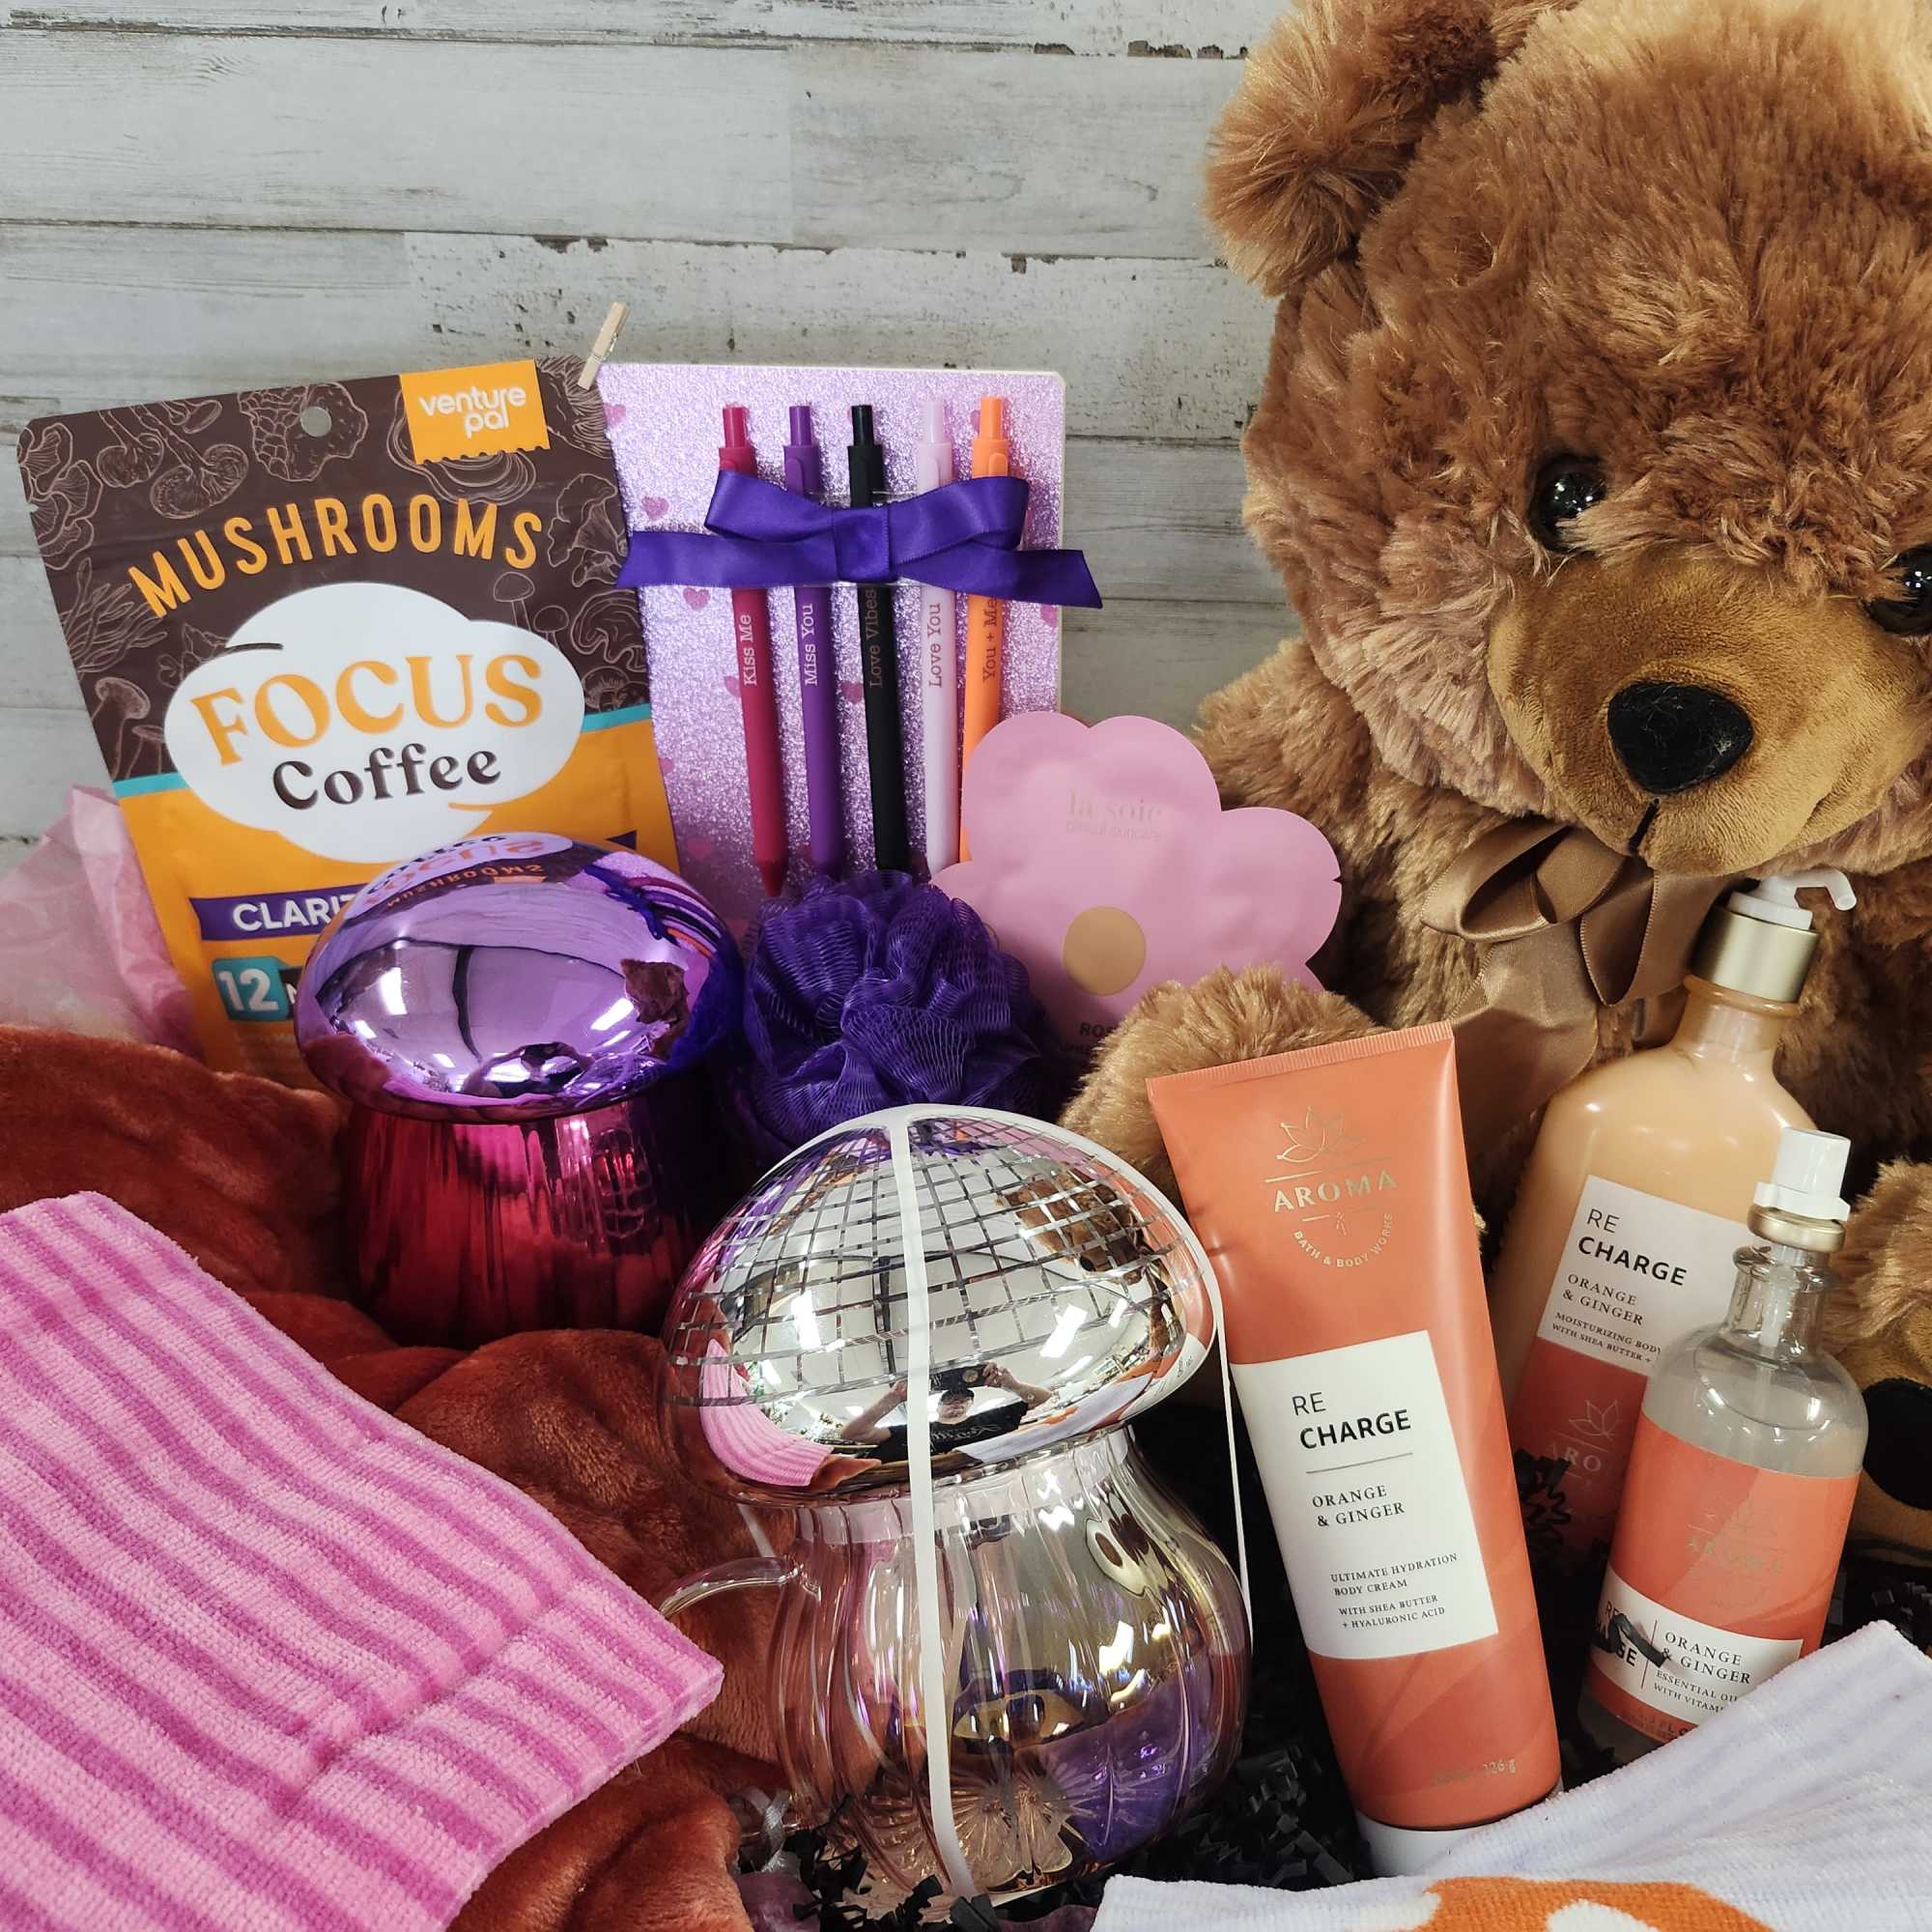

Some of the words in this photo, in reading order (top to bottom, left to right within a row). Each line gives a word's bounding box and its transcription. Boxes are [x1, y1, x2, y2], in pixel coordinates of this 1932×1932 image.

[418, 385, 526, 416] venture
[465, 408, 510, 440] pal
[128, 493, 544, 618] MUSHROOMS
[741, 613, 753, 642] Me
[802, 603, 816, 638] You
[866, 588, 878, 641] Vibes
[926, 602, 942, 639] You
[983, 596, 999, 627] Me
[743, 643, 758, 687] Kiss
[804, 643, 818, 687] Miss
[868, 644, 883, 689] Love
[928, 642, 943, 689] Love
[981, 646, 997, 683] You
[189, 654, 544, 766] FOCUS
[271, 742, 502, 810] Coffee
[218, 967, 279, 1013] 12
[1273, 1168, 1399, 1213] AROMA
[1585, 1208, 1621, 1235] RE
[1293, 1230, 1321, 1260] BATH
[1336, 1252, 1370, 1268] BODY
[1577, 1236, 1688, 1286] CHARGE
[1561, 1288, 1576, 1301] &
[1578, 1294, 1644, 1326] GINGER
[1567, 1273, 1638, 1306] ORANGE
[1551, 1322, 1577, 1338] WITH
[1579, 1334, 1604, 1349] SHEA
[1605, 1343, 1643, 1361] BUTTER
[1554, 1311, 1633, 1346] MOISTURIZING
[1291, 1391, 1326, 1415] RE
[1299, 1408, 1412, 1450] CHARGE
[1311, 1484, 1388, 1509] ORANGE
[1316, 1513, 1330, 1528] &
[1335, 1501, 1406, 1526] GINGER
[1330, 1567, 1389, 1583] ULTIMATE
[1390, 1552, 1459, 1575] HYDRATION
[1333, 1585, 1364, 1597] BODY
[1366, 1578, 1408, 1593] CREAM
[1338, 1605, 1367, 1616] WITH
[1369, 1602, 1397, 1613] SHEA
[1398, 1594, 1439, 1609] BUTTER
[1350, 1611, 1419, 1629] HYALURONIC
[1420, 1605, 1446, 1620] ACID
[1664, 1631, 1743, 1666] ORANGE
[1655, 1670, 1718, 1699] ESSENTIAL
[1679, 1654, 1751, 1685] GINGER
[1653, 1682, 1682, 1701] WITH
